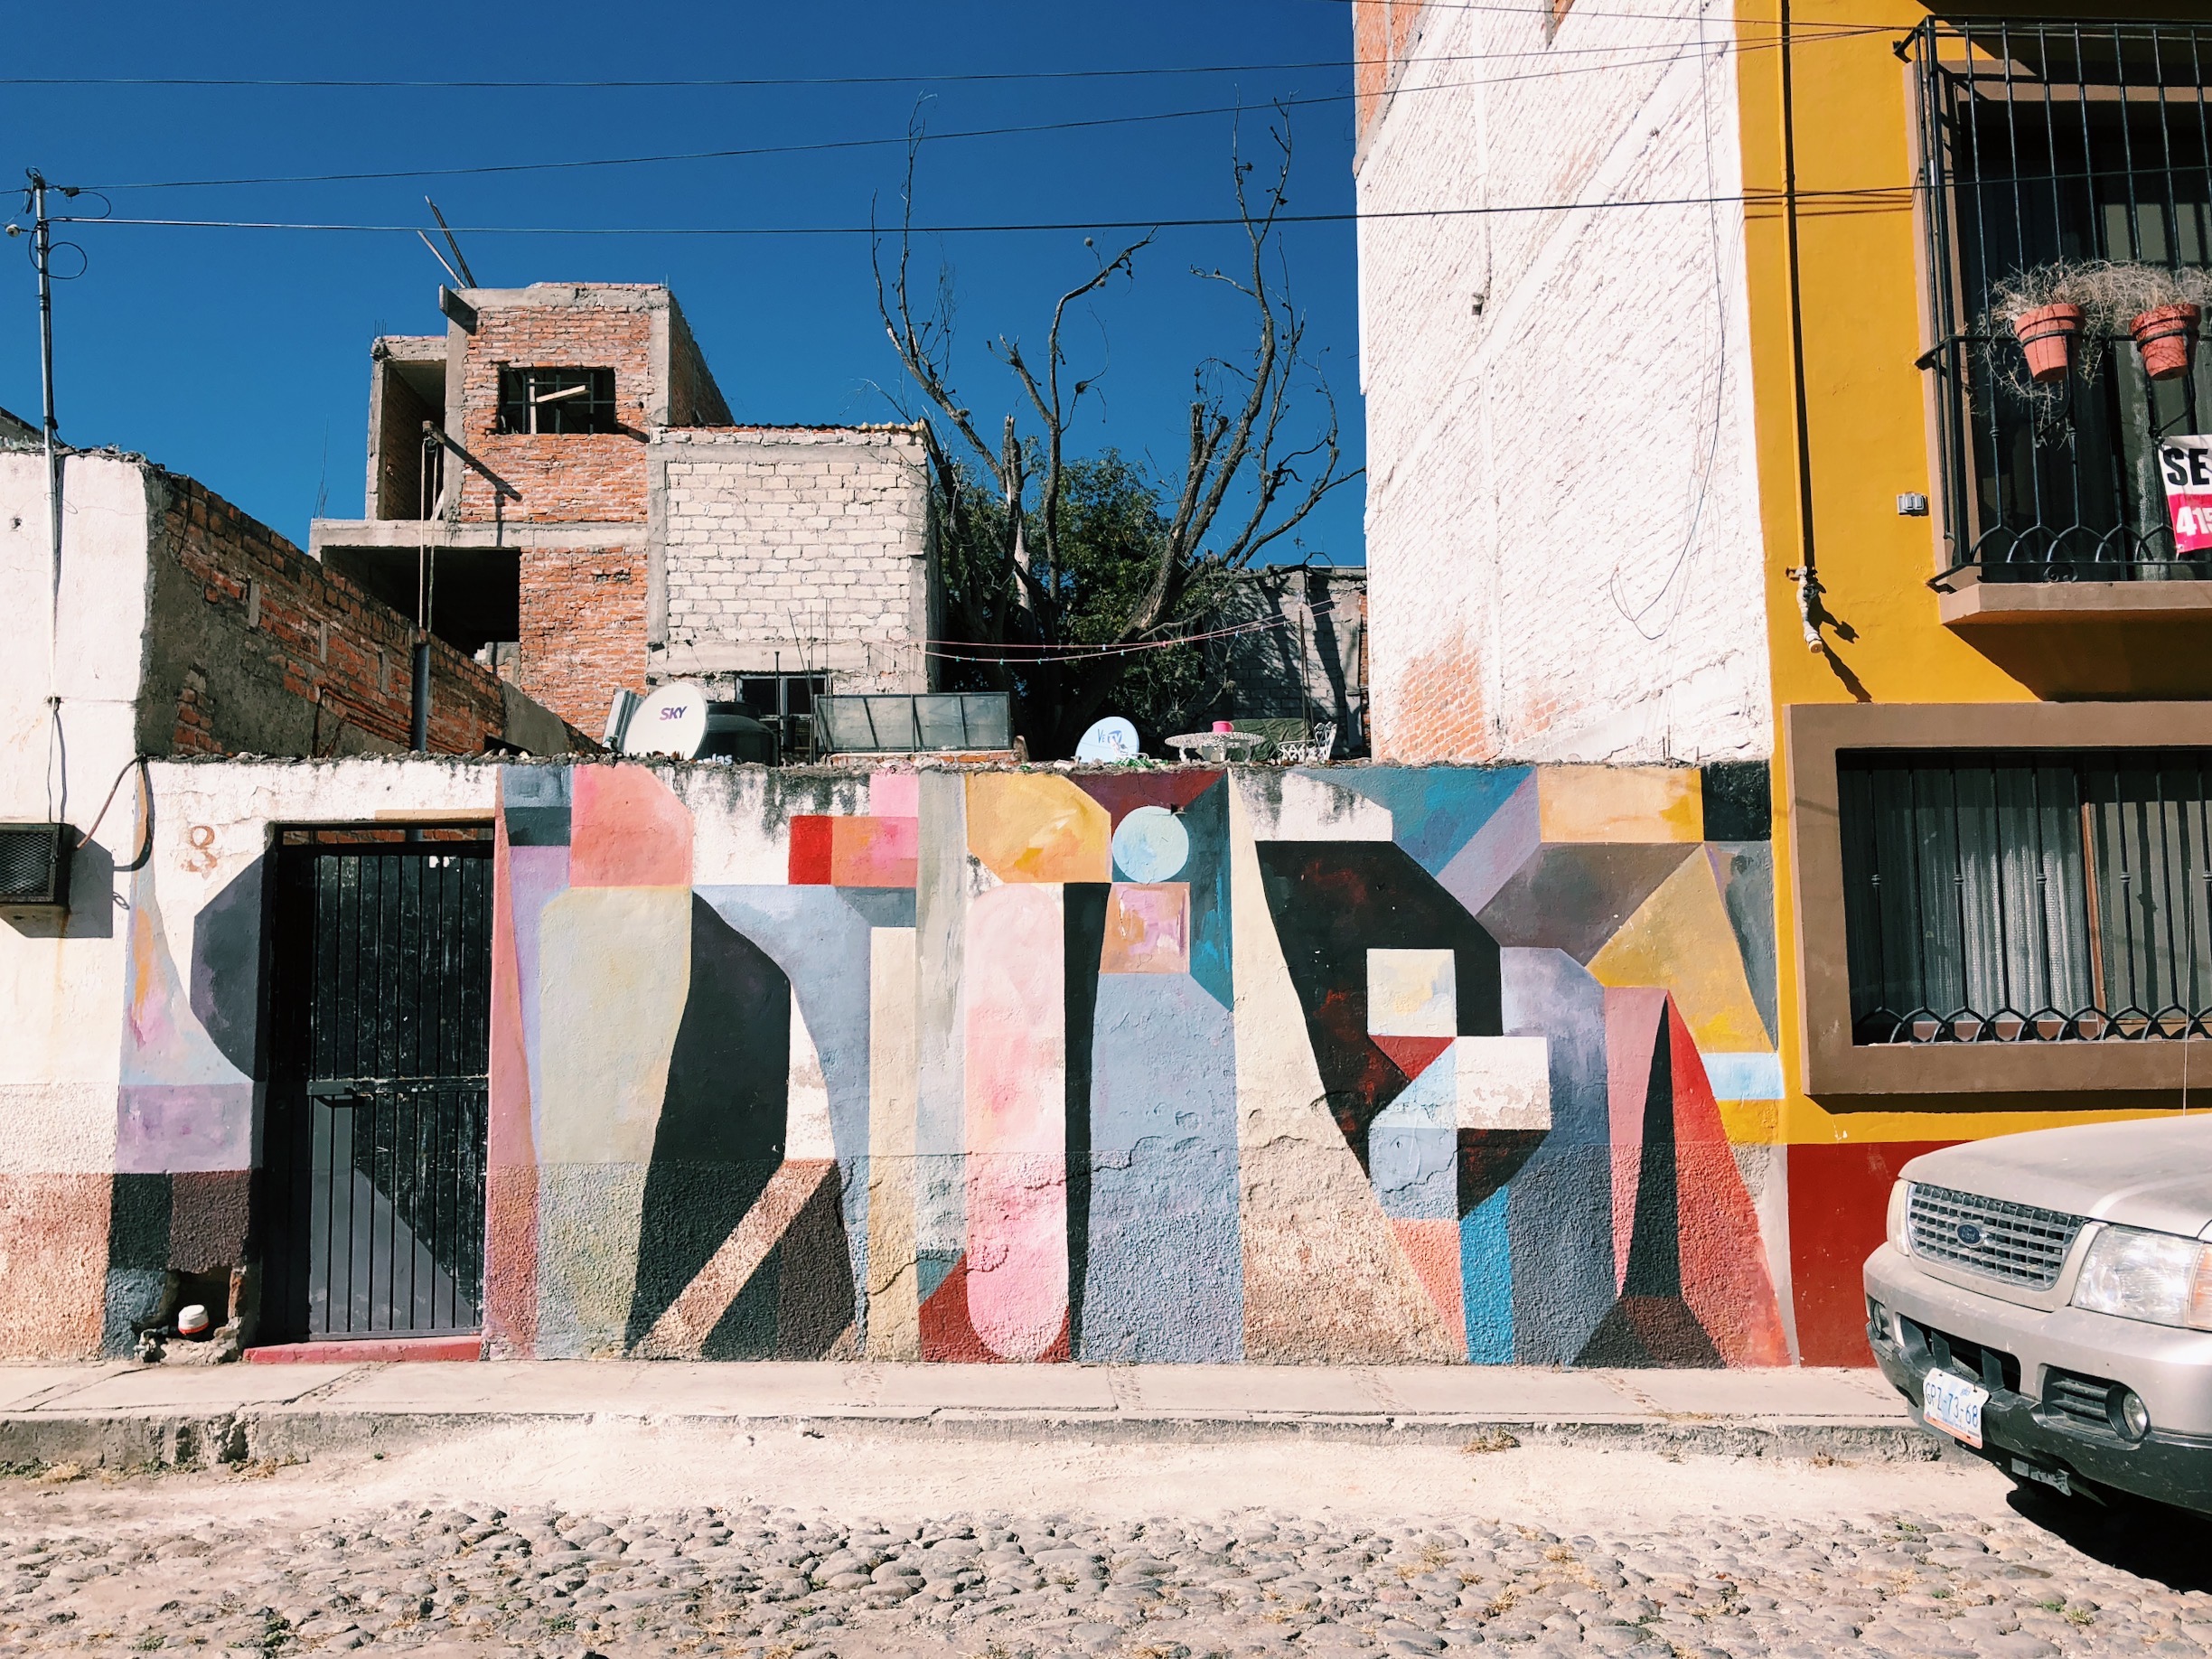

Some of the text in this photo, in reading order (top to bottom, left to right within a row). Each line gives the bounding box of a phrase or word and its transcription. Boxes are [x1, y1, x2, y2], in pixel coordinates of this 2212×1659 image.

[2163, 448, 2210, 486] SE
[659, 706, 688, 721] SKY
[1926, 1382, 1979, 1428] GPZ-73-68
